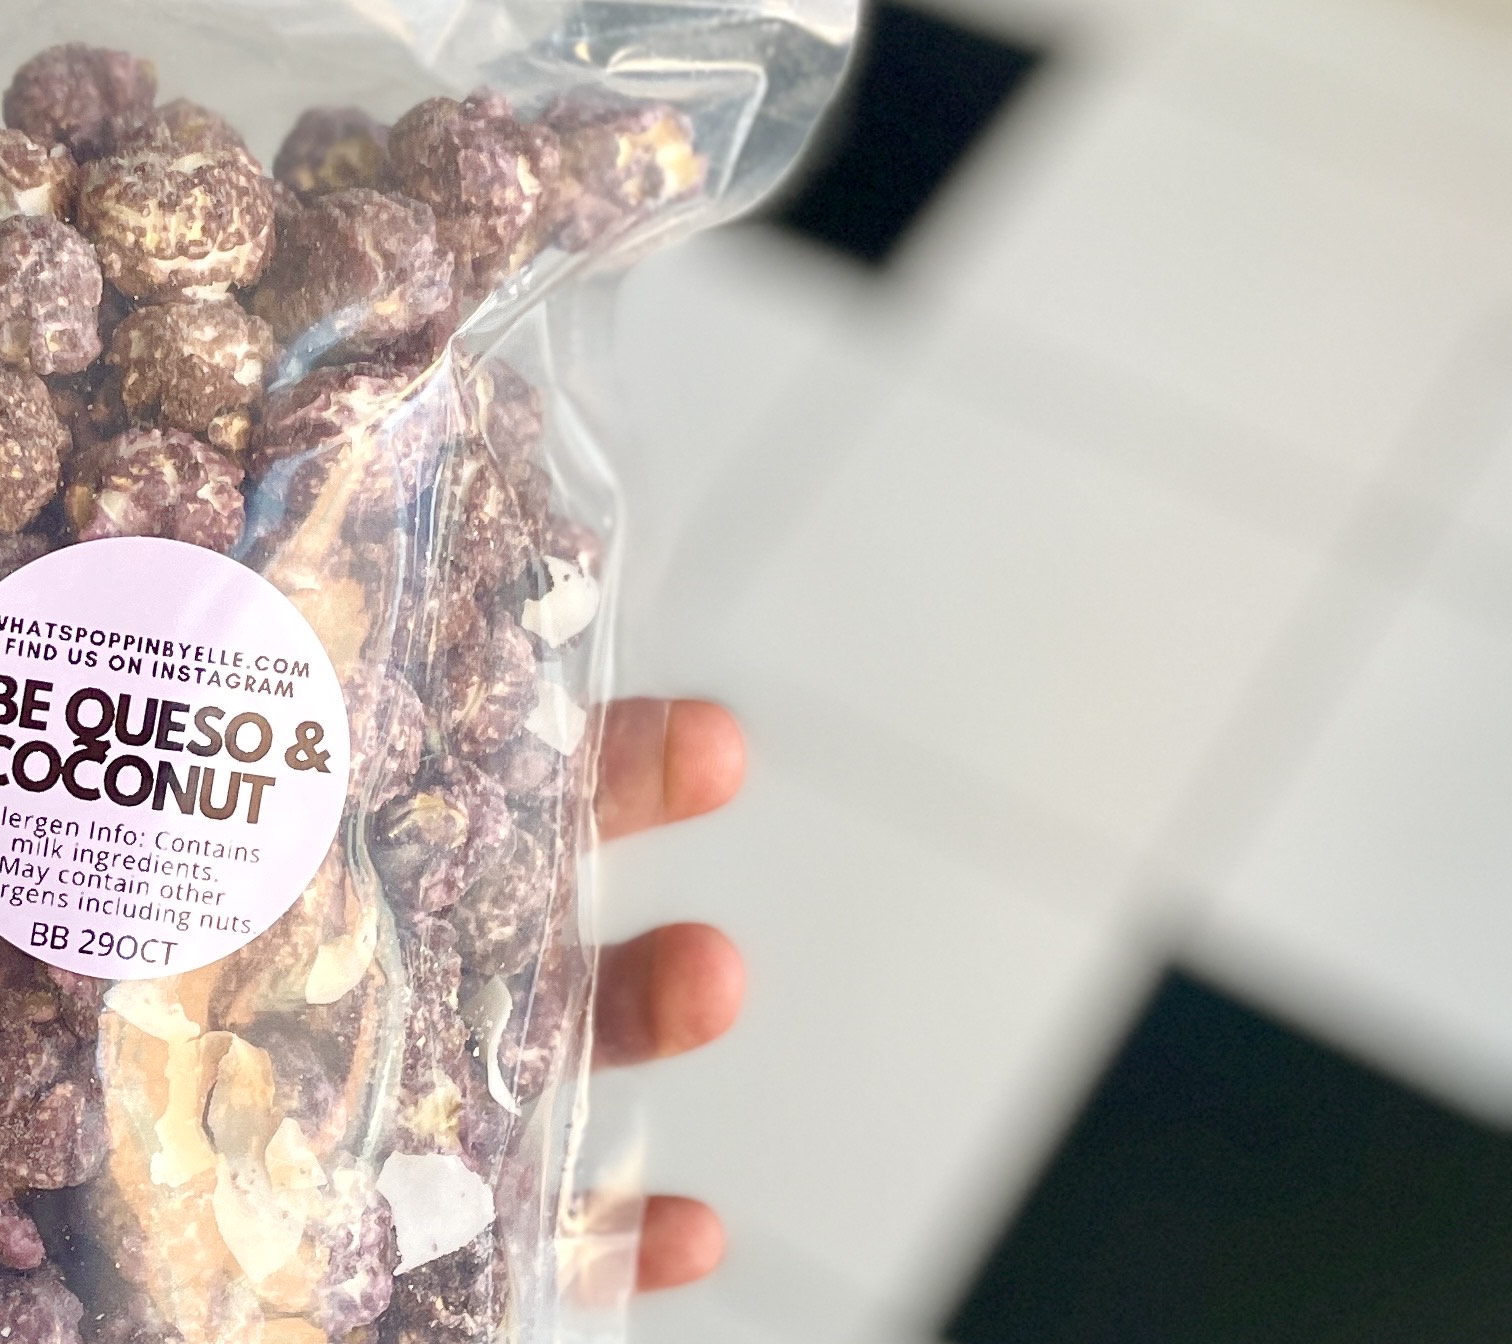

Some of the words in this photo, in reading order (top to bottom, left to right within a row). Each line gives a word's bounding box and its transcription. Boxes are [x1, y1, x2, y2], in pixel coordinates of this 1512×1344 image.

[5, 638, 57, 661] FIND
[68, 650, 98, 668] US
[109, 655, 142, 675] ON
[152, 661, 295, 698] INSTAGRAM
[66, 688, 273, 763] QUESO
[284, 720, 332, 773] &
[11, 836, 62, 861] milk
[73, 846, 218, 883] ingredients.
[90, 821, 145, 848] Info:
[155, 832, 260, 864] Contains
[0, 855, 49, 884] May
[59, 868, 149, 896] contain
[160, 882, 226, 907] other
[30, 922, 68, 950] BB
[78, 891, 191, 931] including
[200, 910, 257, 935] nuts.
